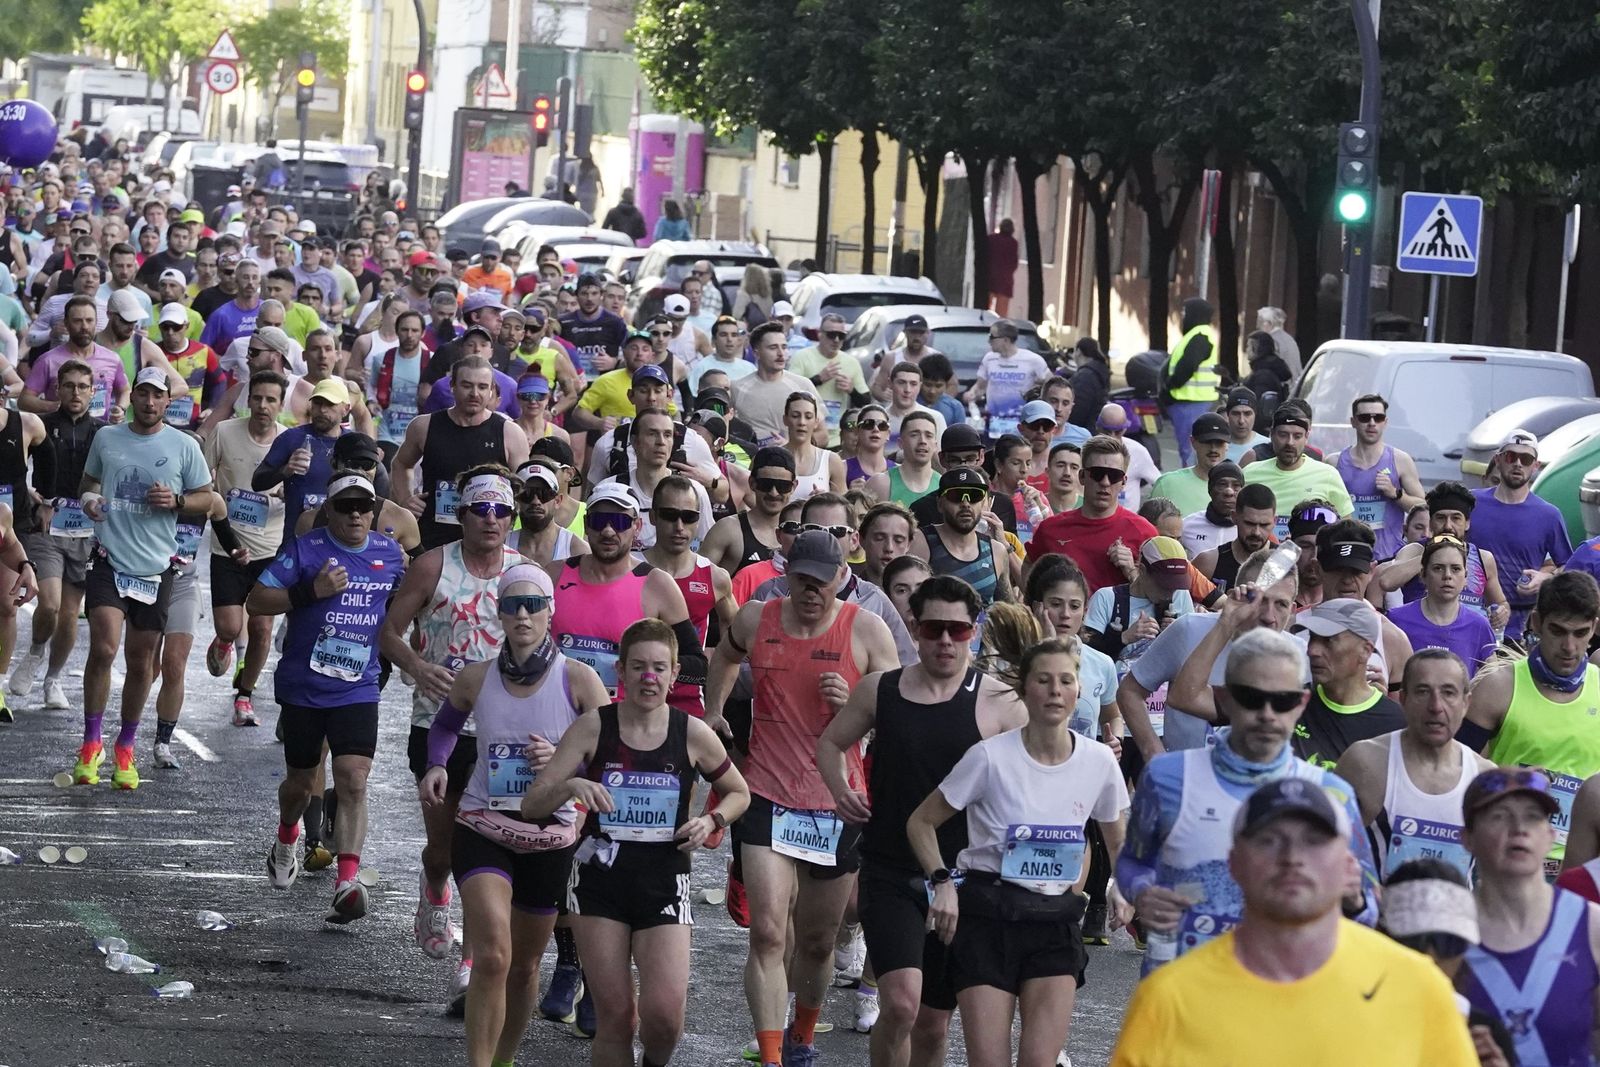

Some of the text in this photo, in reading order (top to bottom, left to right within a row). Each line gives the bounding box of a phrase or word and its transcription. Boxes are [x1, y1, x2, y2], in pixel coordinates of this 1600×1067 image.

[213, 71, 233, 83] 30
[242, 493, 267, 504] ZURICH
[231, 511, 257, 523] JESUS
[64, 520, 82, 528] MAX
[340, 592, 373, 607] CHILE
[325, 611, 379, 626] GERMAN
[338, 630, 369, 642] ZURICH
[577, 638, 614, 651] ZURICH
[316, 650, 365, 671] GERMAIN
[627, 775, 671, 787] ZURICH
[628, 796, 650, 806] 7014
[608, 807, 667, 825] CLÀUDIA
[1035, 829, 1079, 840] ZURICH
[1421, 824, 1460, 840] ZURIC
[780, 828, 830, 851] JUANMA
[1420, 847, 1444, 859] 7914
[1020, 861, 1064, 877] ANAIS
